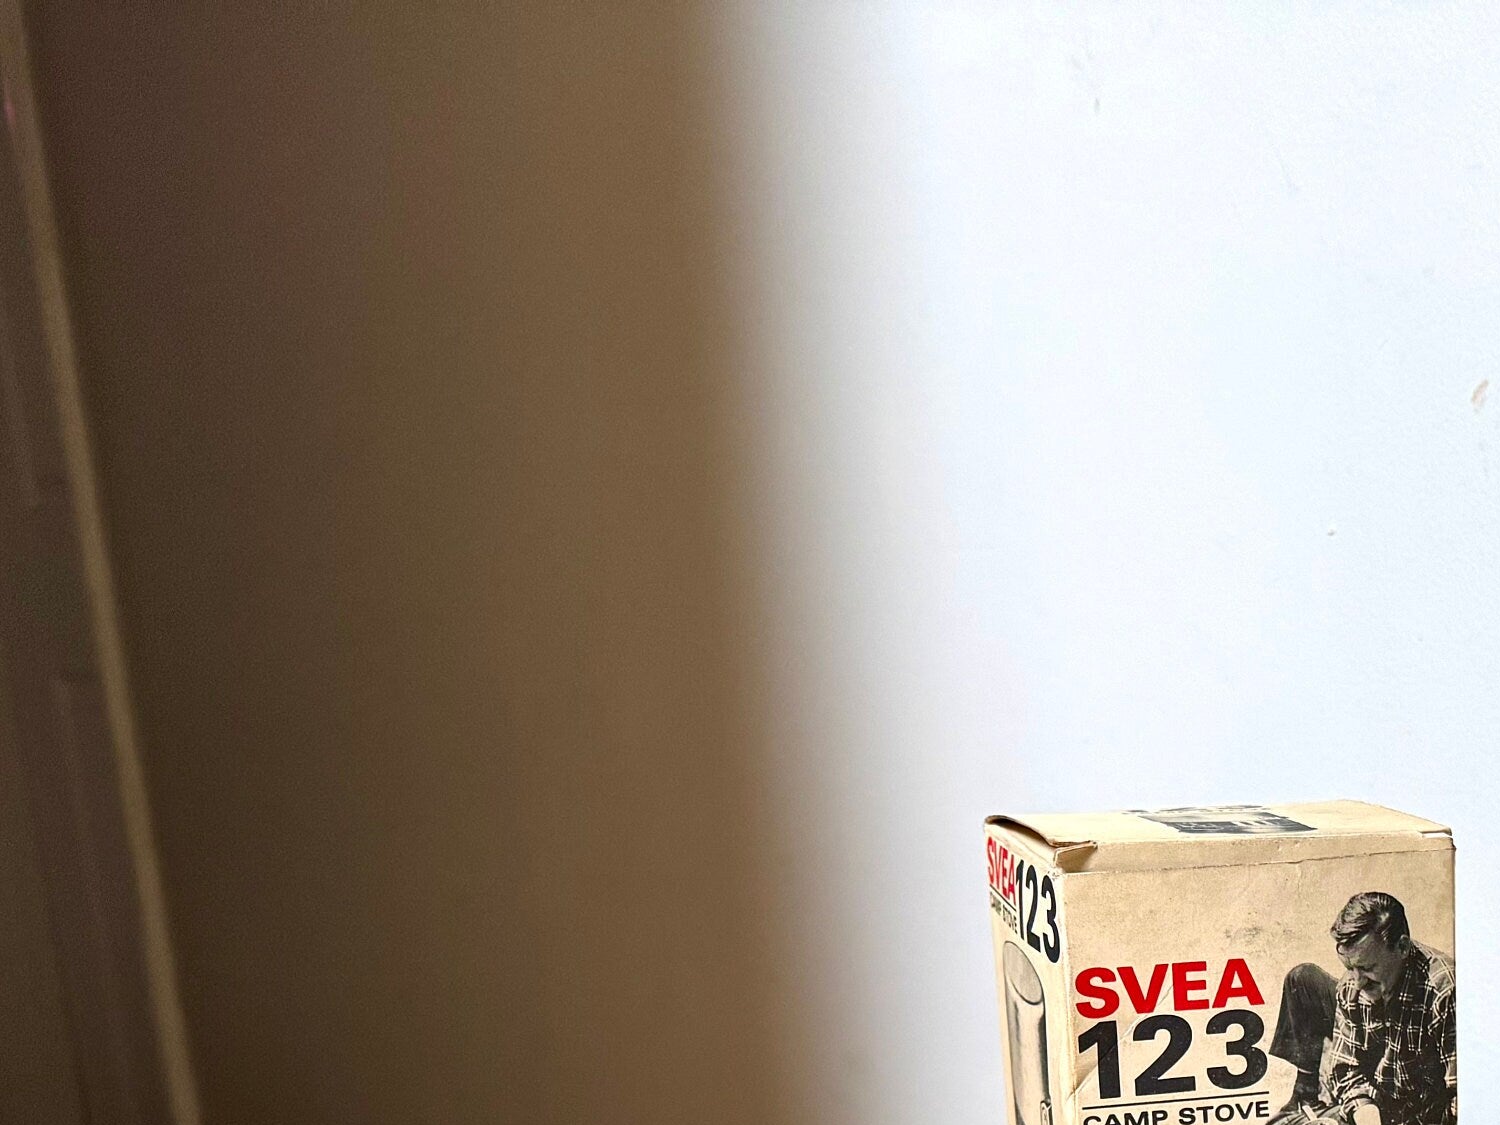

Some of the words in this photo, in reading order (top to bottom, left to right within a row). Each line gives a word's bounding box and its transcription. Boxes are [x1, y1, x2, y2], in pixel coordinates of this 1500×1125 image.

[987, 836, 1017, 907] SVEA
[1016, 859, 1061, 963] 123
[1075, 958, 1265, 1019] SVEA
[1078, 1009, 1268, 1100] 123
[1178, 1100, 1270, 1125] STOVE
